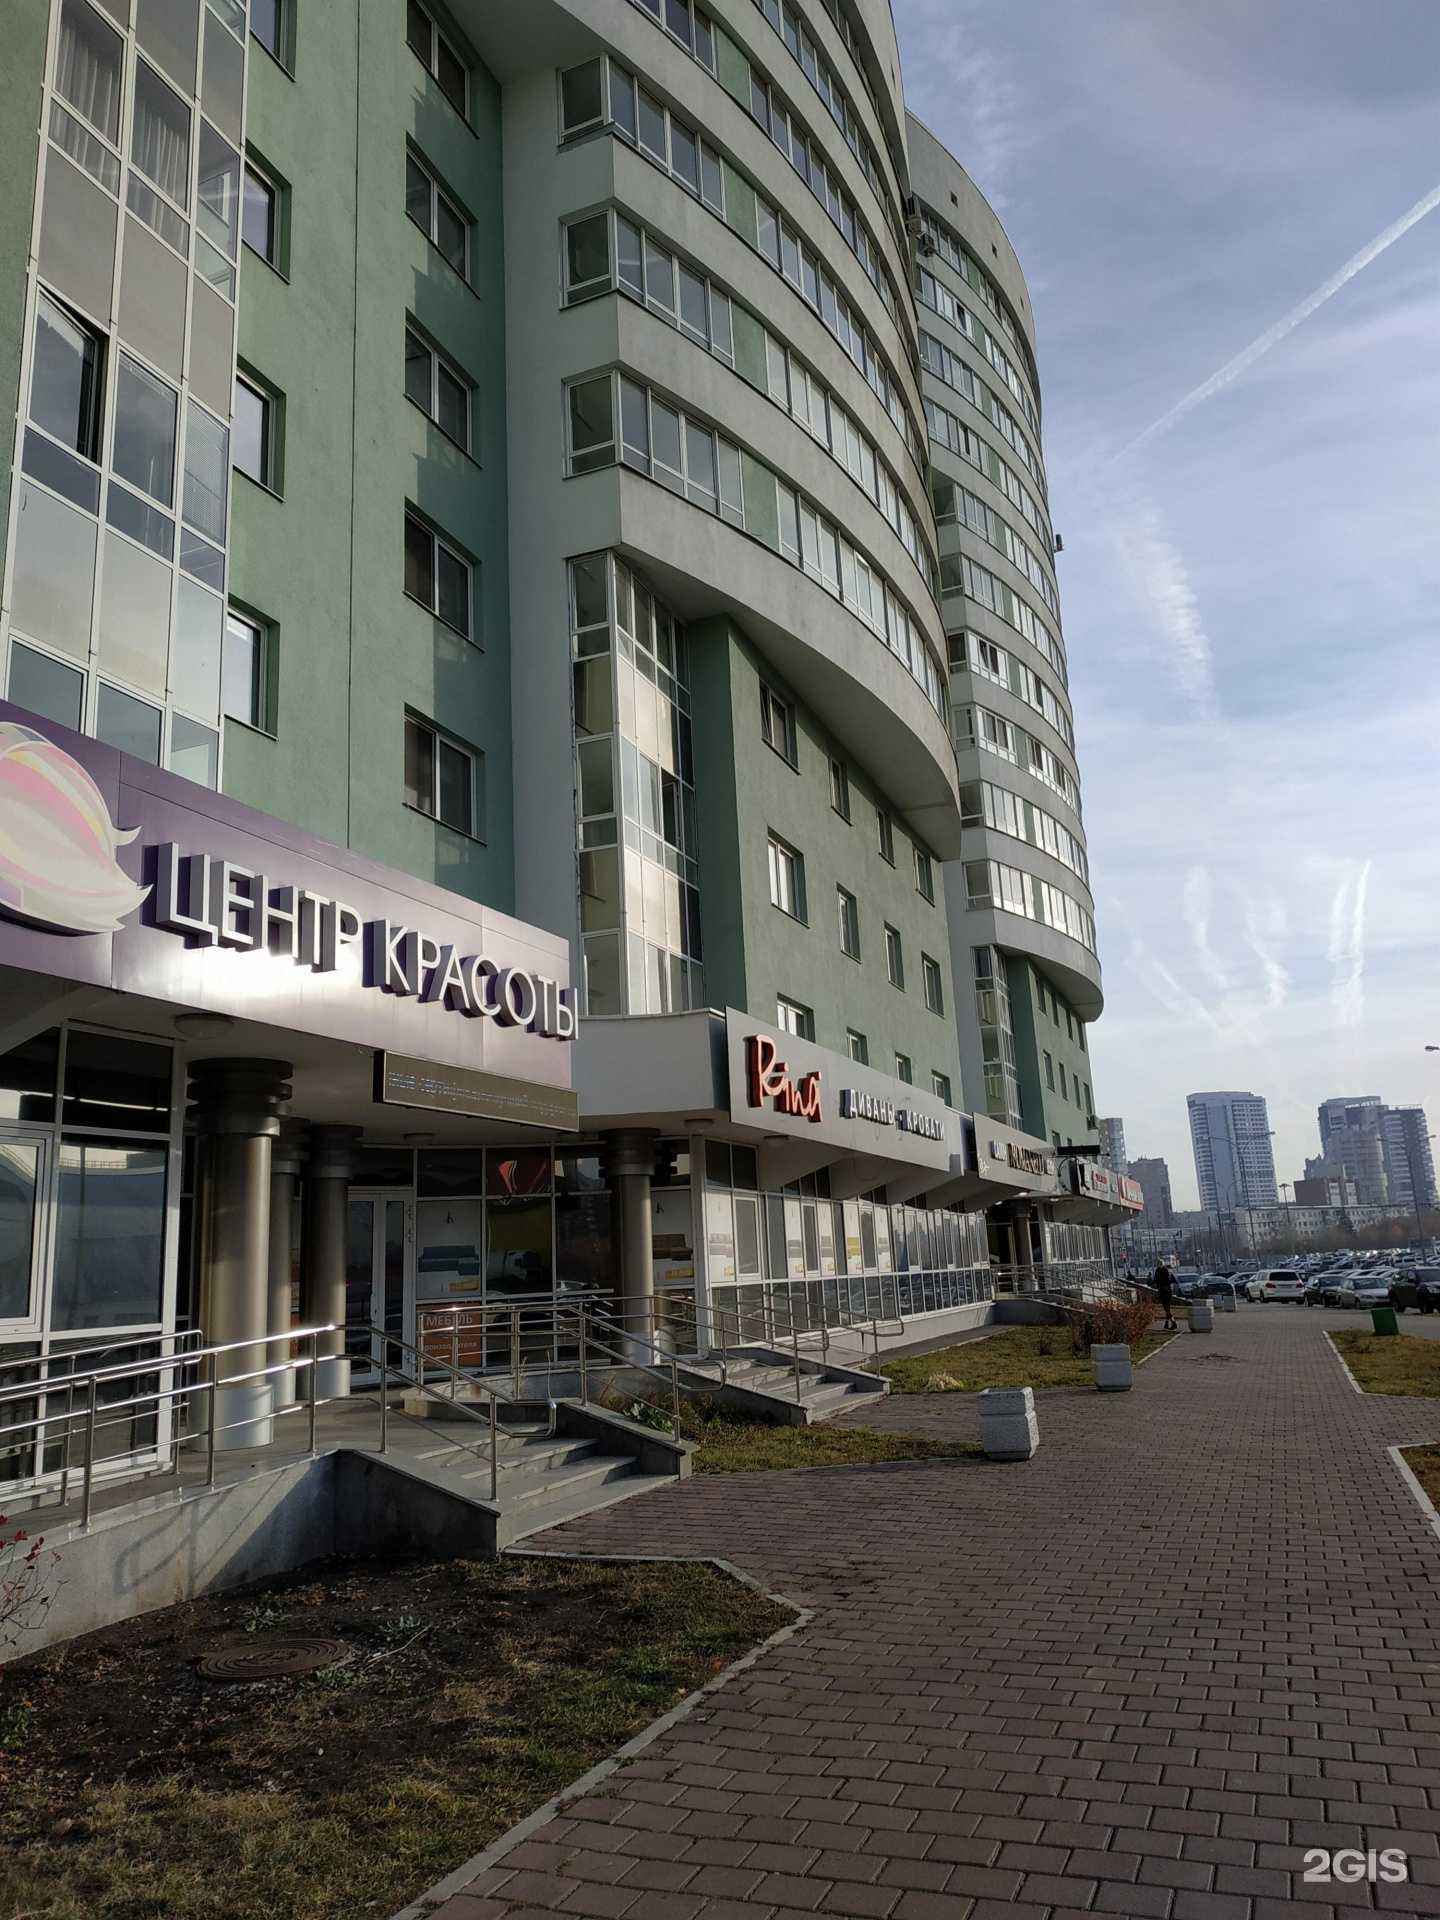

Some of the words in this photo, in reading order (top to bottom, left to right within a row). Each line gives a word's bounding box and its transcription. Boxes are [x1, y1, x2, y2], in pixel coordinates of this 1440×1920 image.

[155, 842, 361, 970] ЦЕНТР
[376, 919, 579, 1040] КРАСОТЫ
[849, 1088, 895, 1125] ДИВАНЫ
[906, 1109, 945, 1140] КРОВАТИ
